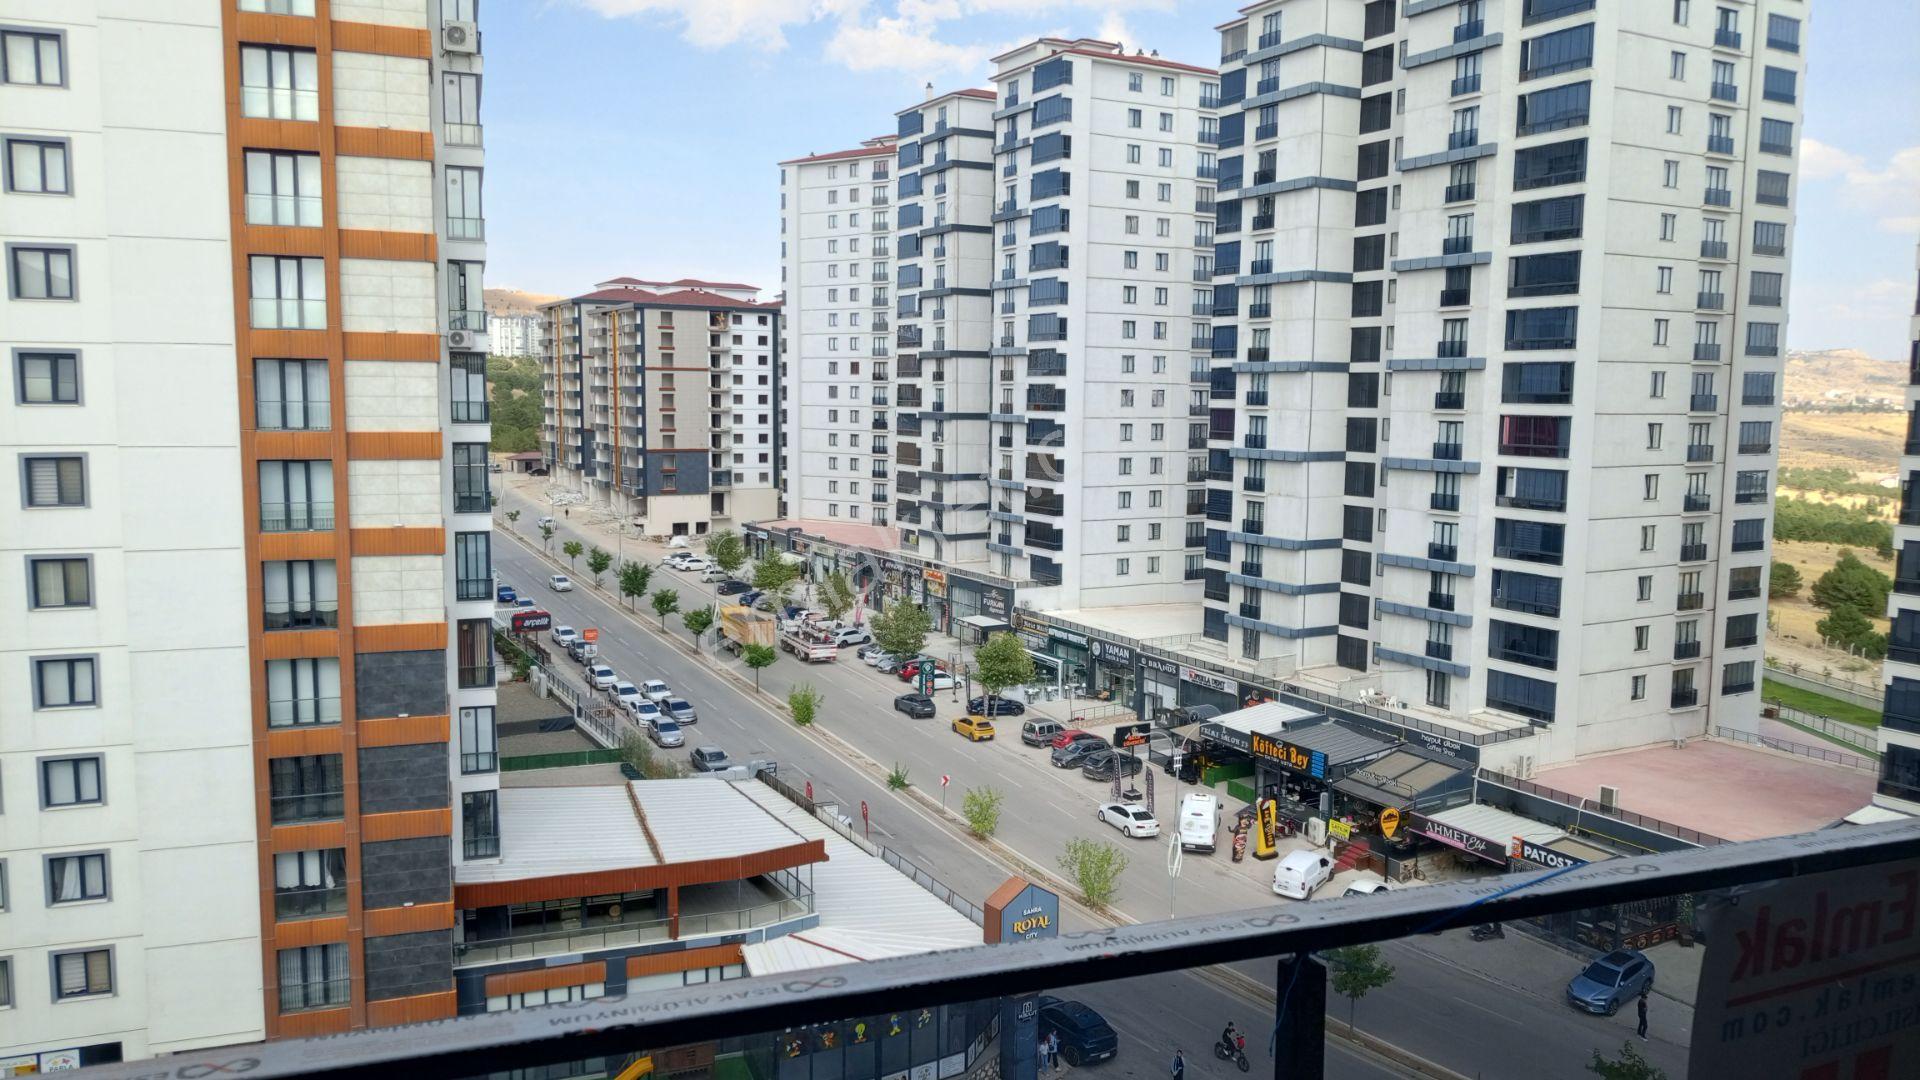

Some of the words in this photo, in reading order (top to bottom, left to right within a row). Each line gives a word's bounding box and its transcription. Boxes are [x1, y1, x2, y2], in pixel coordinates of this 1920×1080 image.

[1105, 643, 1130, 659] YAMAN
[1253, 735, 1287, 760] Köfteci
[1290, 746, 1309, 769] Bey
[1426, 743, 1441, 752] Coffee
[1443, 747, 1456, 757] Shop
[1425, 821, 1469, 843] AHMET
[1023, 906, 1042, 916] SAHRA
[1013, 915, 1051, 934] ROYAL
[1025, 932, 1038, 940] CITY
